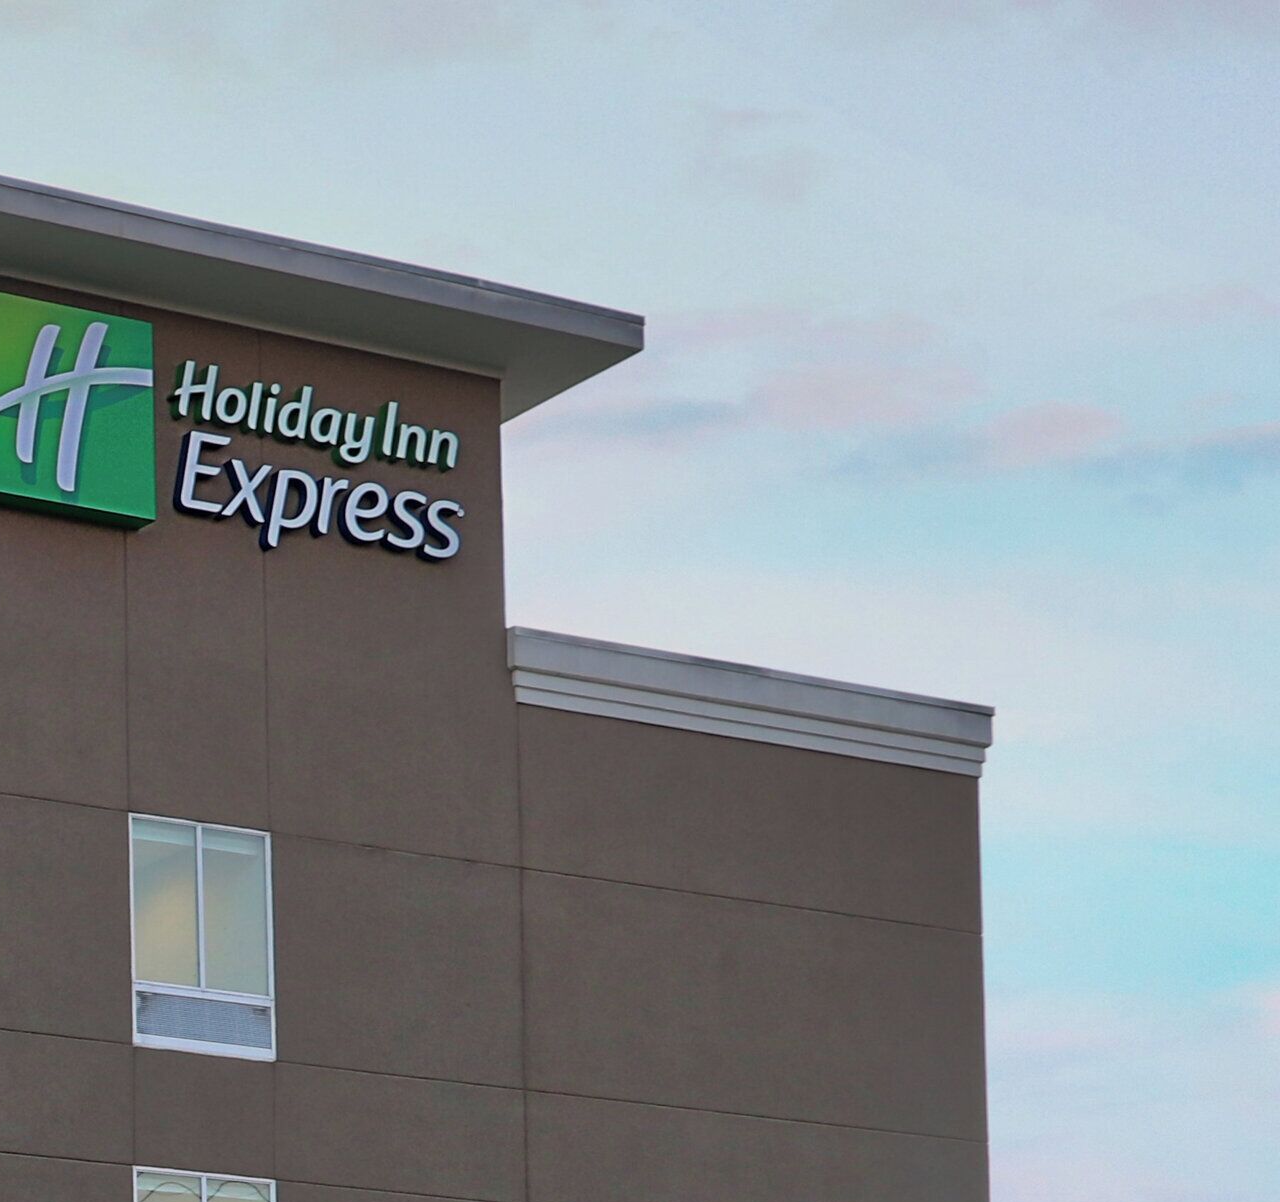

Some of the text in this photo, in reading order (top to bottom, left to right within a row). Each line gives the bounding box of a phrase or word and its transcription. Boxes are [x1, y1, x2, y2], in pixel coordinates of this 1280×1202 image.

[171, 359, 460, 469] Holiday Inn
[176, 429, 462, 559] Express
